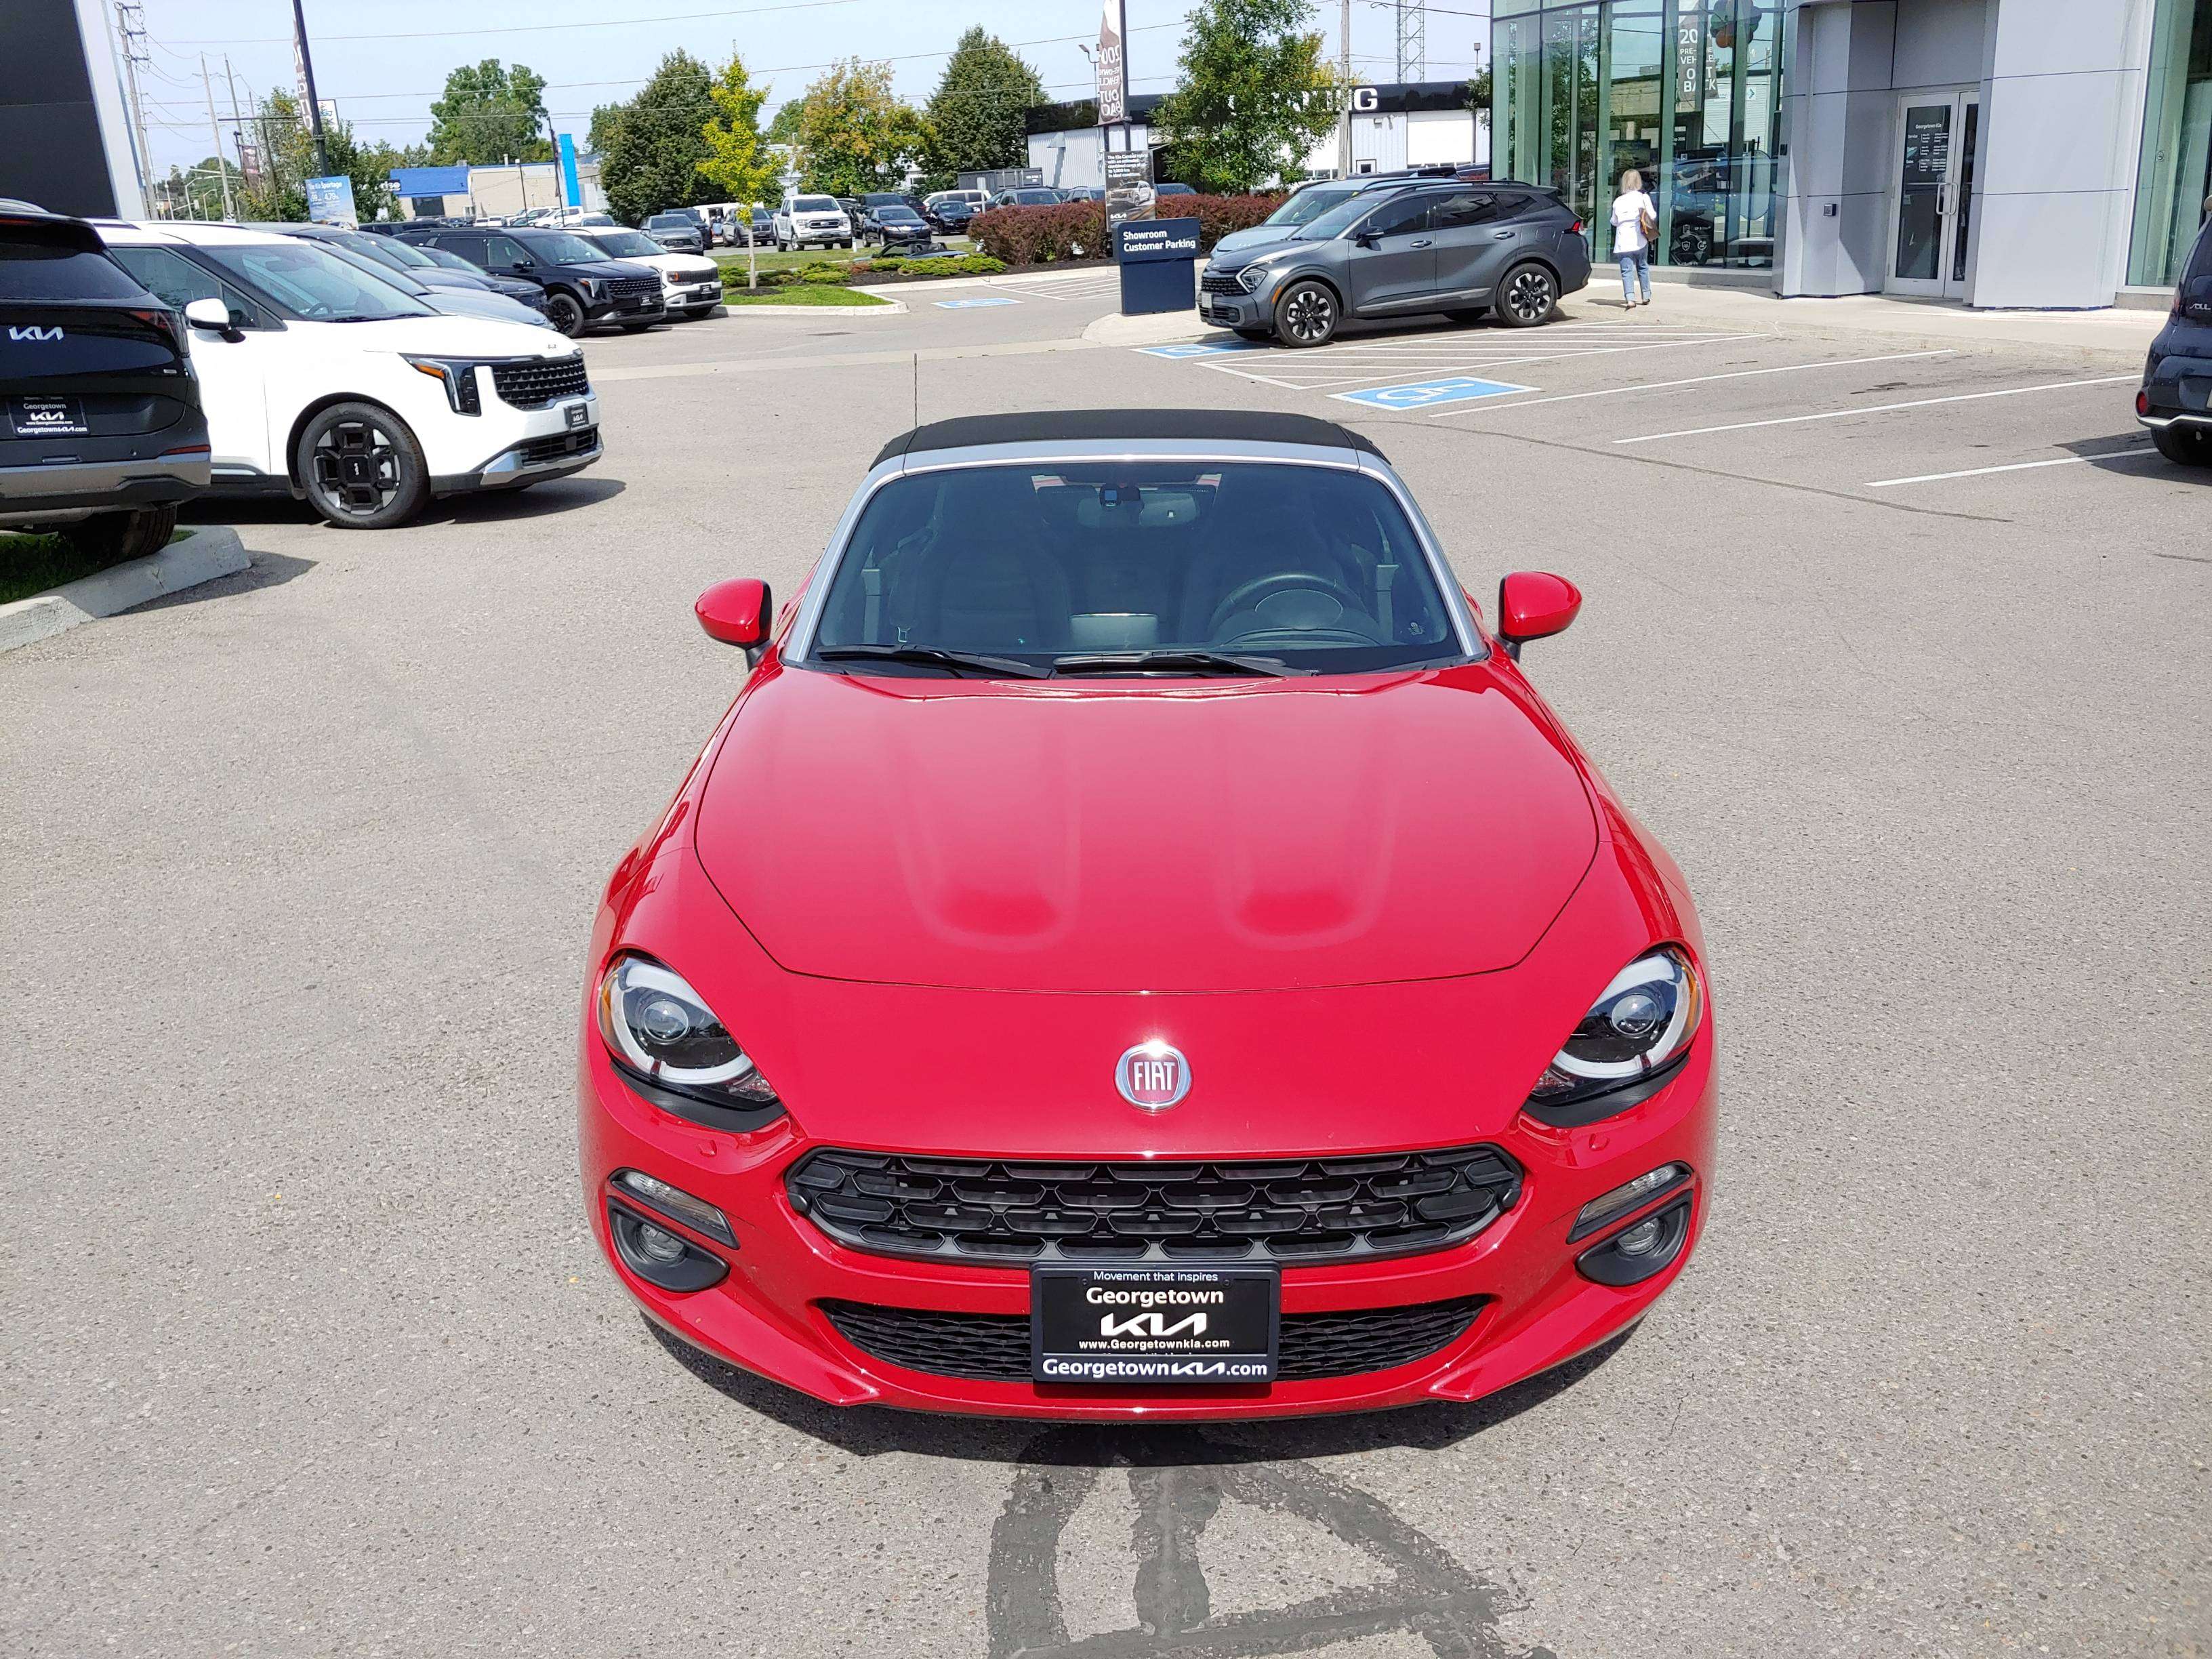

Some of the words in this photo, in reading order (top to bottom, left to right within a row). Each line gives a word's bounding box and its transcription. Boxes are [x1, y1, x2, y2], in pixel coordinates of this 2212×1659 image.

[321, 181, 342, 189] Sportage
[1123, 230, 1167, 241] Showroom
[1123, 242, 1164, 252] Customer
[1165, 239, 1196, 249] Parking
[9, 326, 64, 340] KIA
[30, 411, 64, 421] KIA
[1133, 1061, 1175, 1090] FIAT
[1093, 1271, 1151, 1282] Movement
[1153, 1271, 1174, 1281] that
[1176, 1272, 1218, 1282] inspires
[1086, 1287, 1224, 1308] Georgetown
[1101, 1313, 1207, 1336] KIA
[1079, 1338, 1230, 1351] www.Georgetownkia.com
